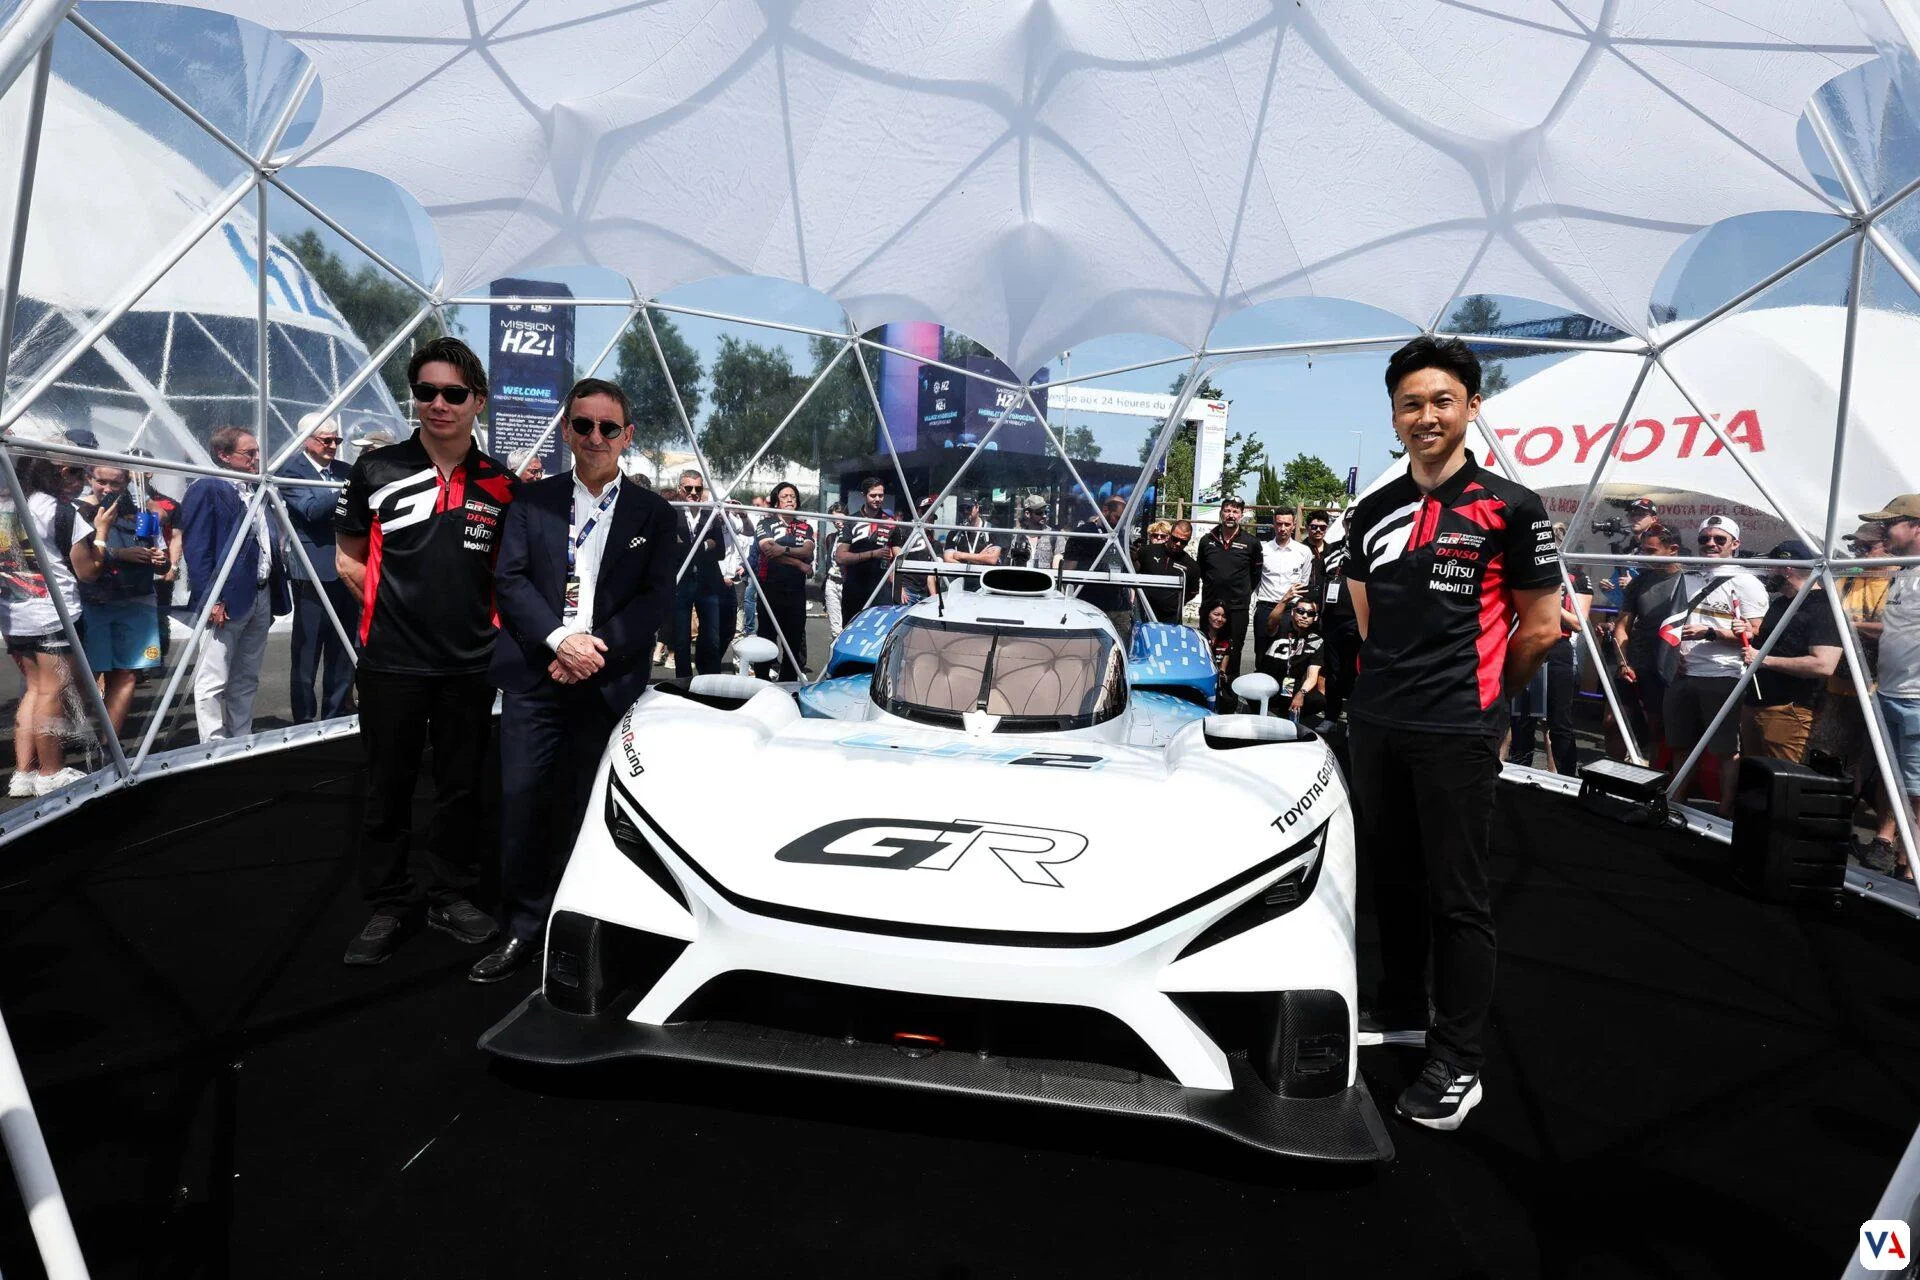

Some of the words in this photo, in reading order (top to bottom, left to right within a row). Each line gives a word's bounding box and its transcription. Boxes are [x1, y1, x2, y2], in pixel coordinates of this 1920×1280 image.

[500, 320, 555, 332] MISSION
[500, 329, 555, 356] H24
[503, 386, 551, 397] WELCOME
[1101, 397, 1113, 405] 24
[1117, 397, 1150, 408] Heures
[1153, 400, 1166, 410] du
[1484, 410, 1766, 466] TOYOTA
[1658, 504, 1695, 516] OYOTA
[467, 513, 497, 525] DENSO
[1436, 548, 1480, 560] DENSO
[1432, 559, 1475, 578] FUJITSU
[1429, 580, 1460, 593] Mobil
[622, 731, 645, 777] Racing
[1270, 783, 1324, 834] TOYOTA
[774, 817, 1090, 888] GR
